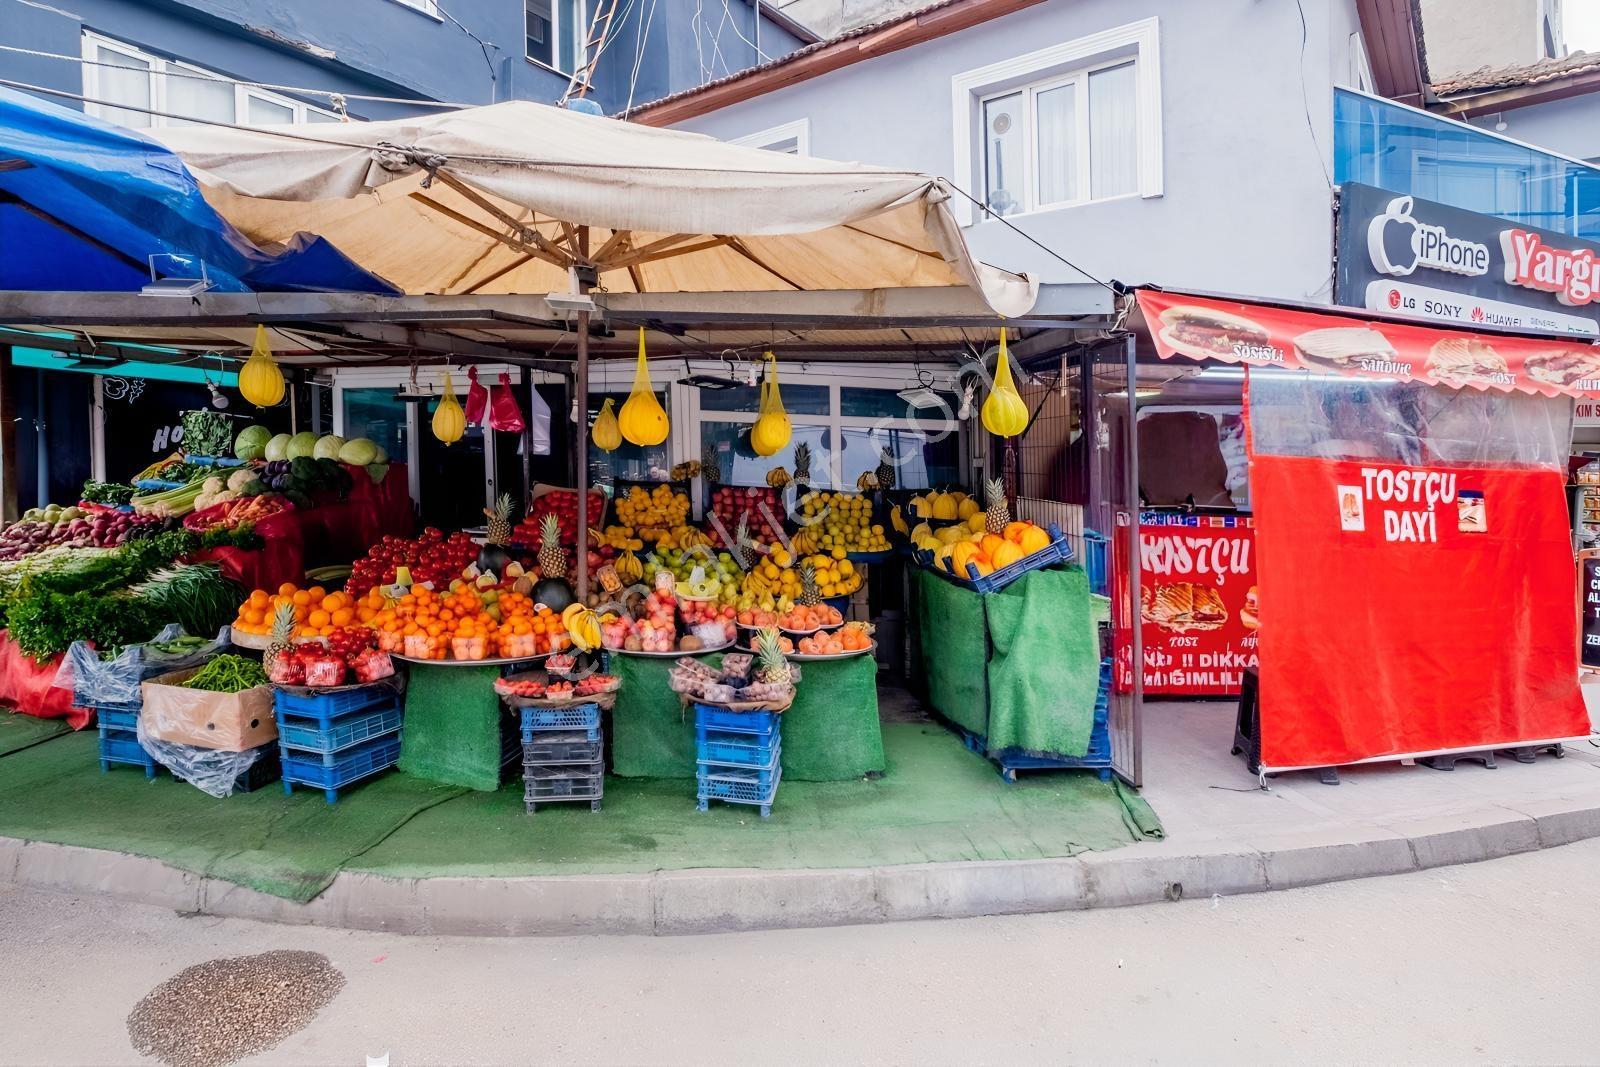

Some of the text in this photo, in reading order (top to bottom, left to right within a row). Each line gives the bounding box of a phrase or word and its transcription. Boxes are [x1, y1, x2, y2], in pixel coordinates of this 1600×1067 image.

[1420, 229, 1487, 270] iPhone
[1403, 296, 1416, 309] LG
[1424, 300, 1462, 318] SONY
[1486, 312, 1522, 327] HUAWEI
[152, 425, 185, 453] HO
[1361, 467, 1457, 511] TOSTÇU
[1169, 636, 1199, 647] TOST
[1200, 651, 1259, 667] DİKKA
